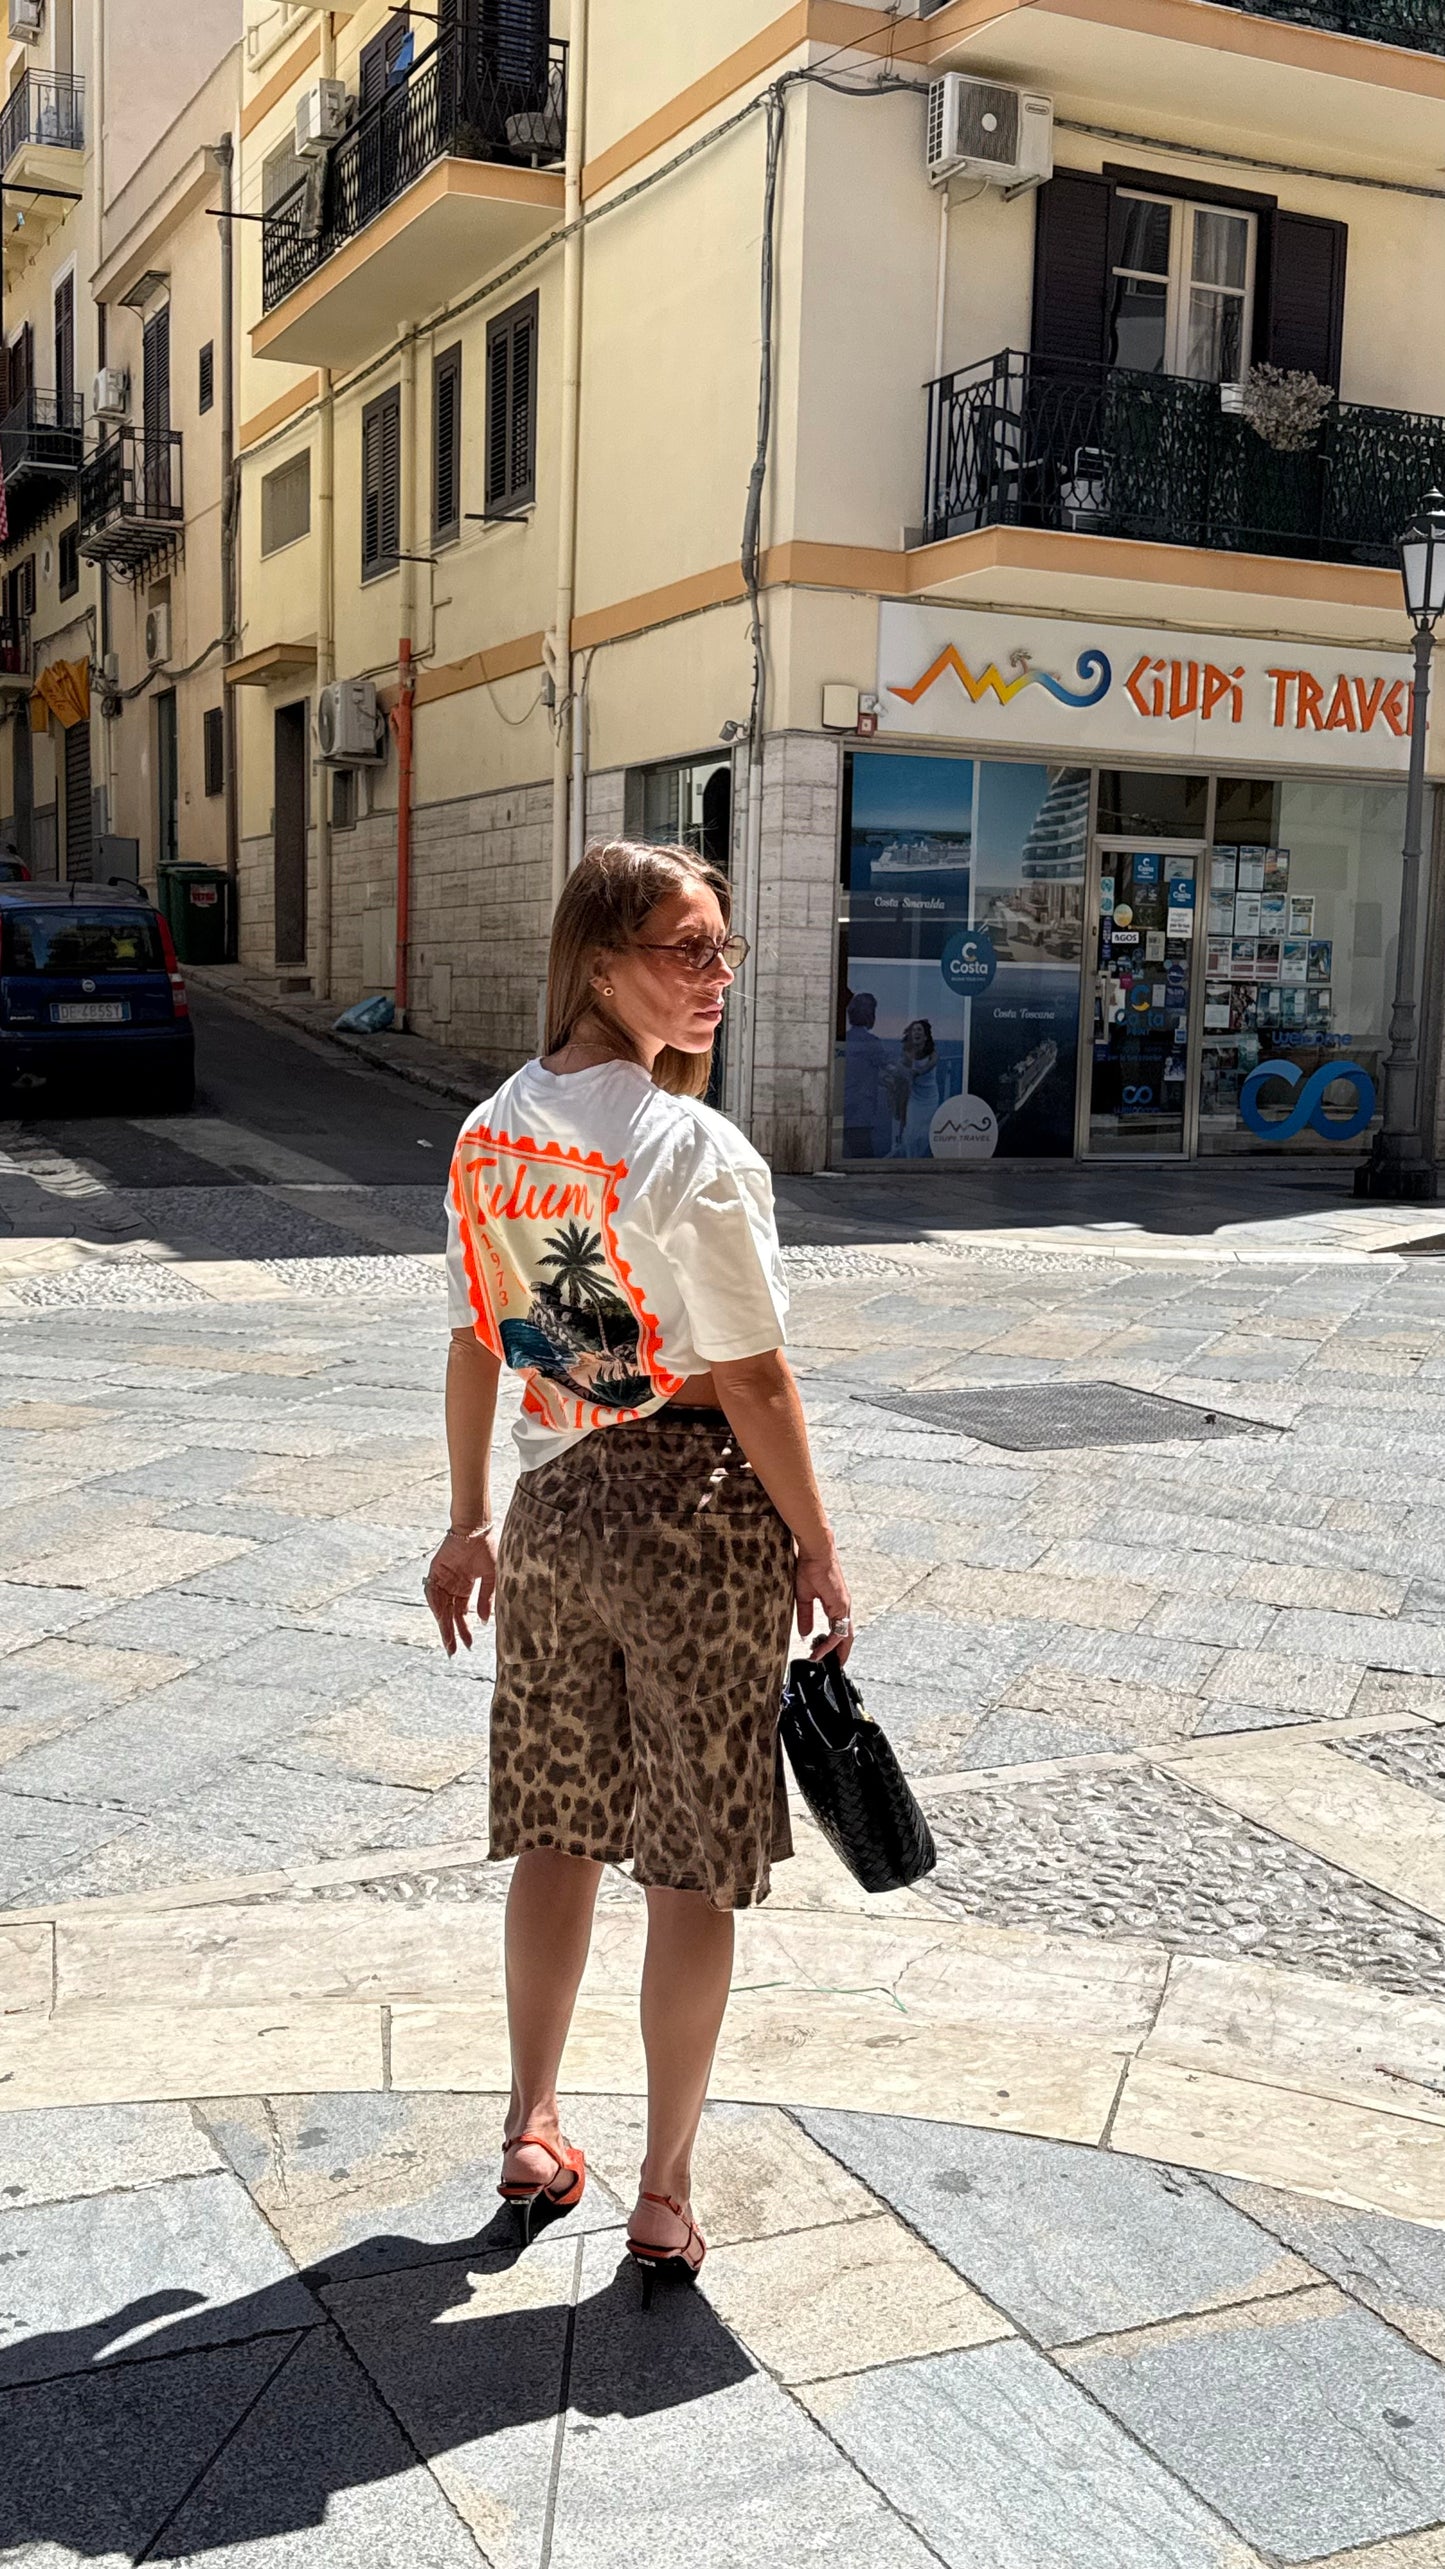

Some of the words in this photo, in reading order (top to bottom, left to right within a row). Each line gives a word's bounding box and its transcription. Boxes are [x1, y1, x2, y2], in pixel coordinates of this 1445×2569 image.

[874, 896, 899, 908] Costa
[902, 897, 945, 909] Smeralda
[950, 959, 988, 974] Costa
[993, 1007, 1017, 1019] Costa
[1020, 1007, 1055, 1019] Toscana
[466, 1157, 595, 1225] Tulum
[480, 1232, 509, 1306] 1973
